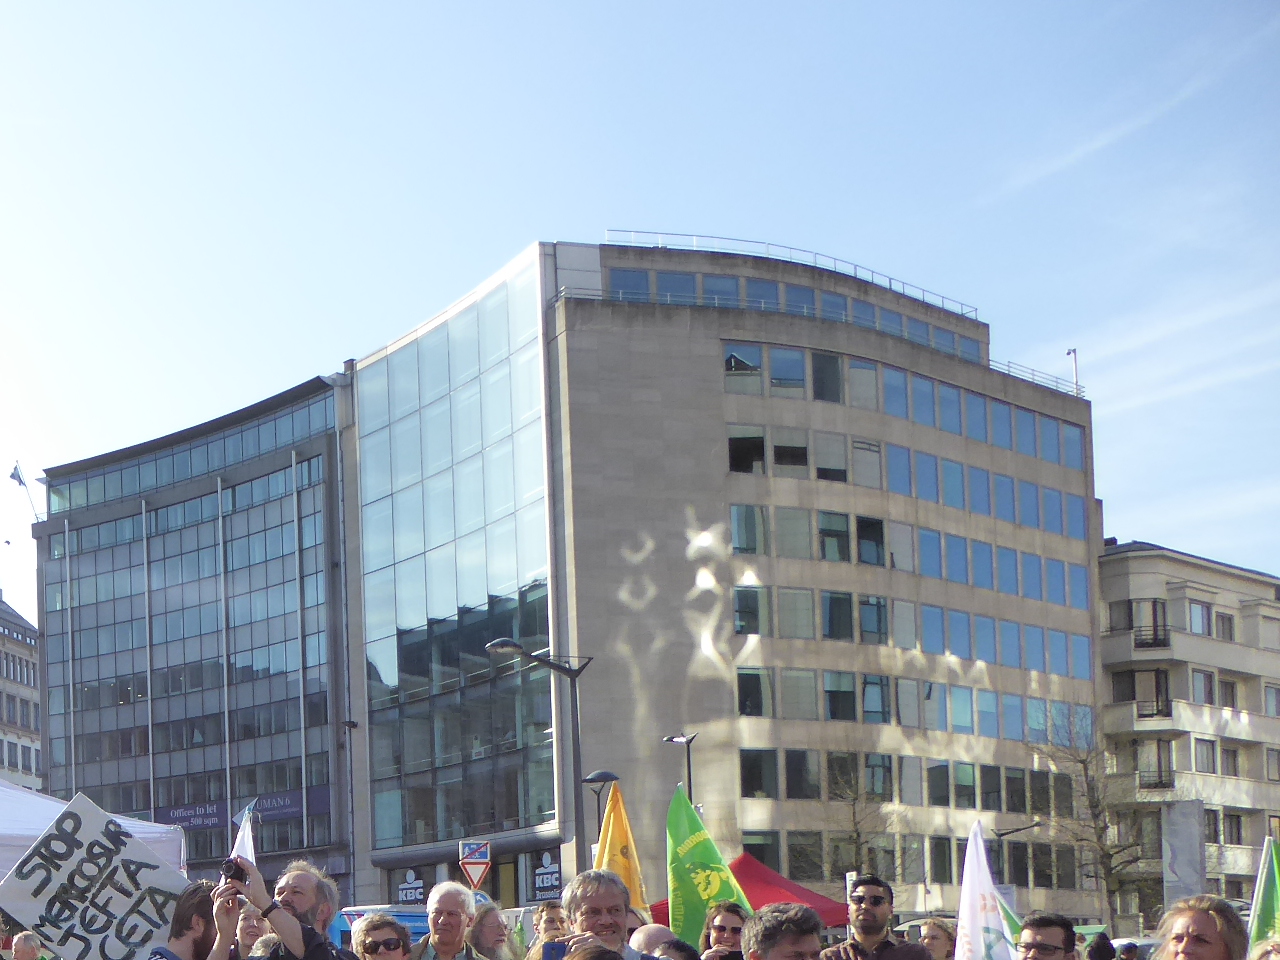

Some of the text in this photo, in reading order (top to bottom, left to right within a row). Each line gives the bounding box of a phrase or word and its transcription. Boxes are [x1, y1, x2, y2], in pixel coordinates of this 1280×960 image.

[170, 803, 217, 818] Offices to let
[256, 797, 284, 810] UMAN
[190, 817, 202, 826] 500
[203, 817, 218, 826] sqm
[15, 811, 84, 898] STOP
[32, 819, 132, 943] MERCOSUR
[535, 873, 559, 888] KBC
[398, 888, 424, 901] KBC
[57, 858, 160, 960] JEFTA
